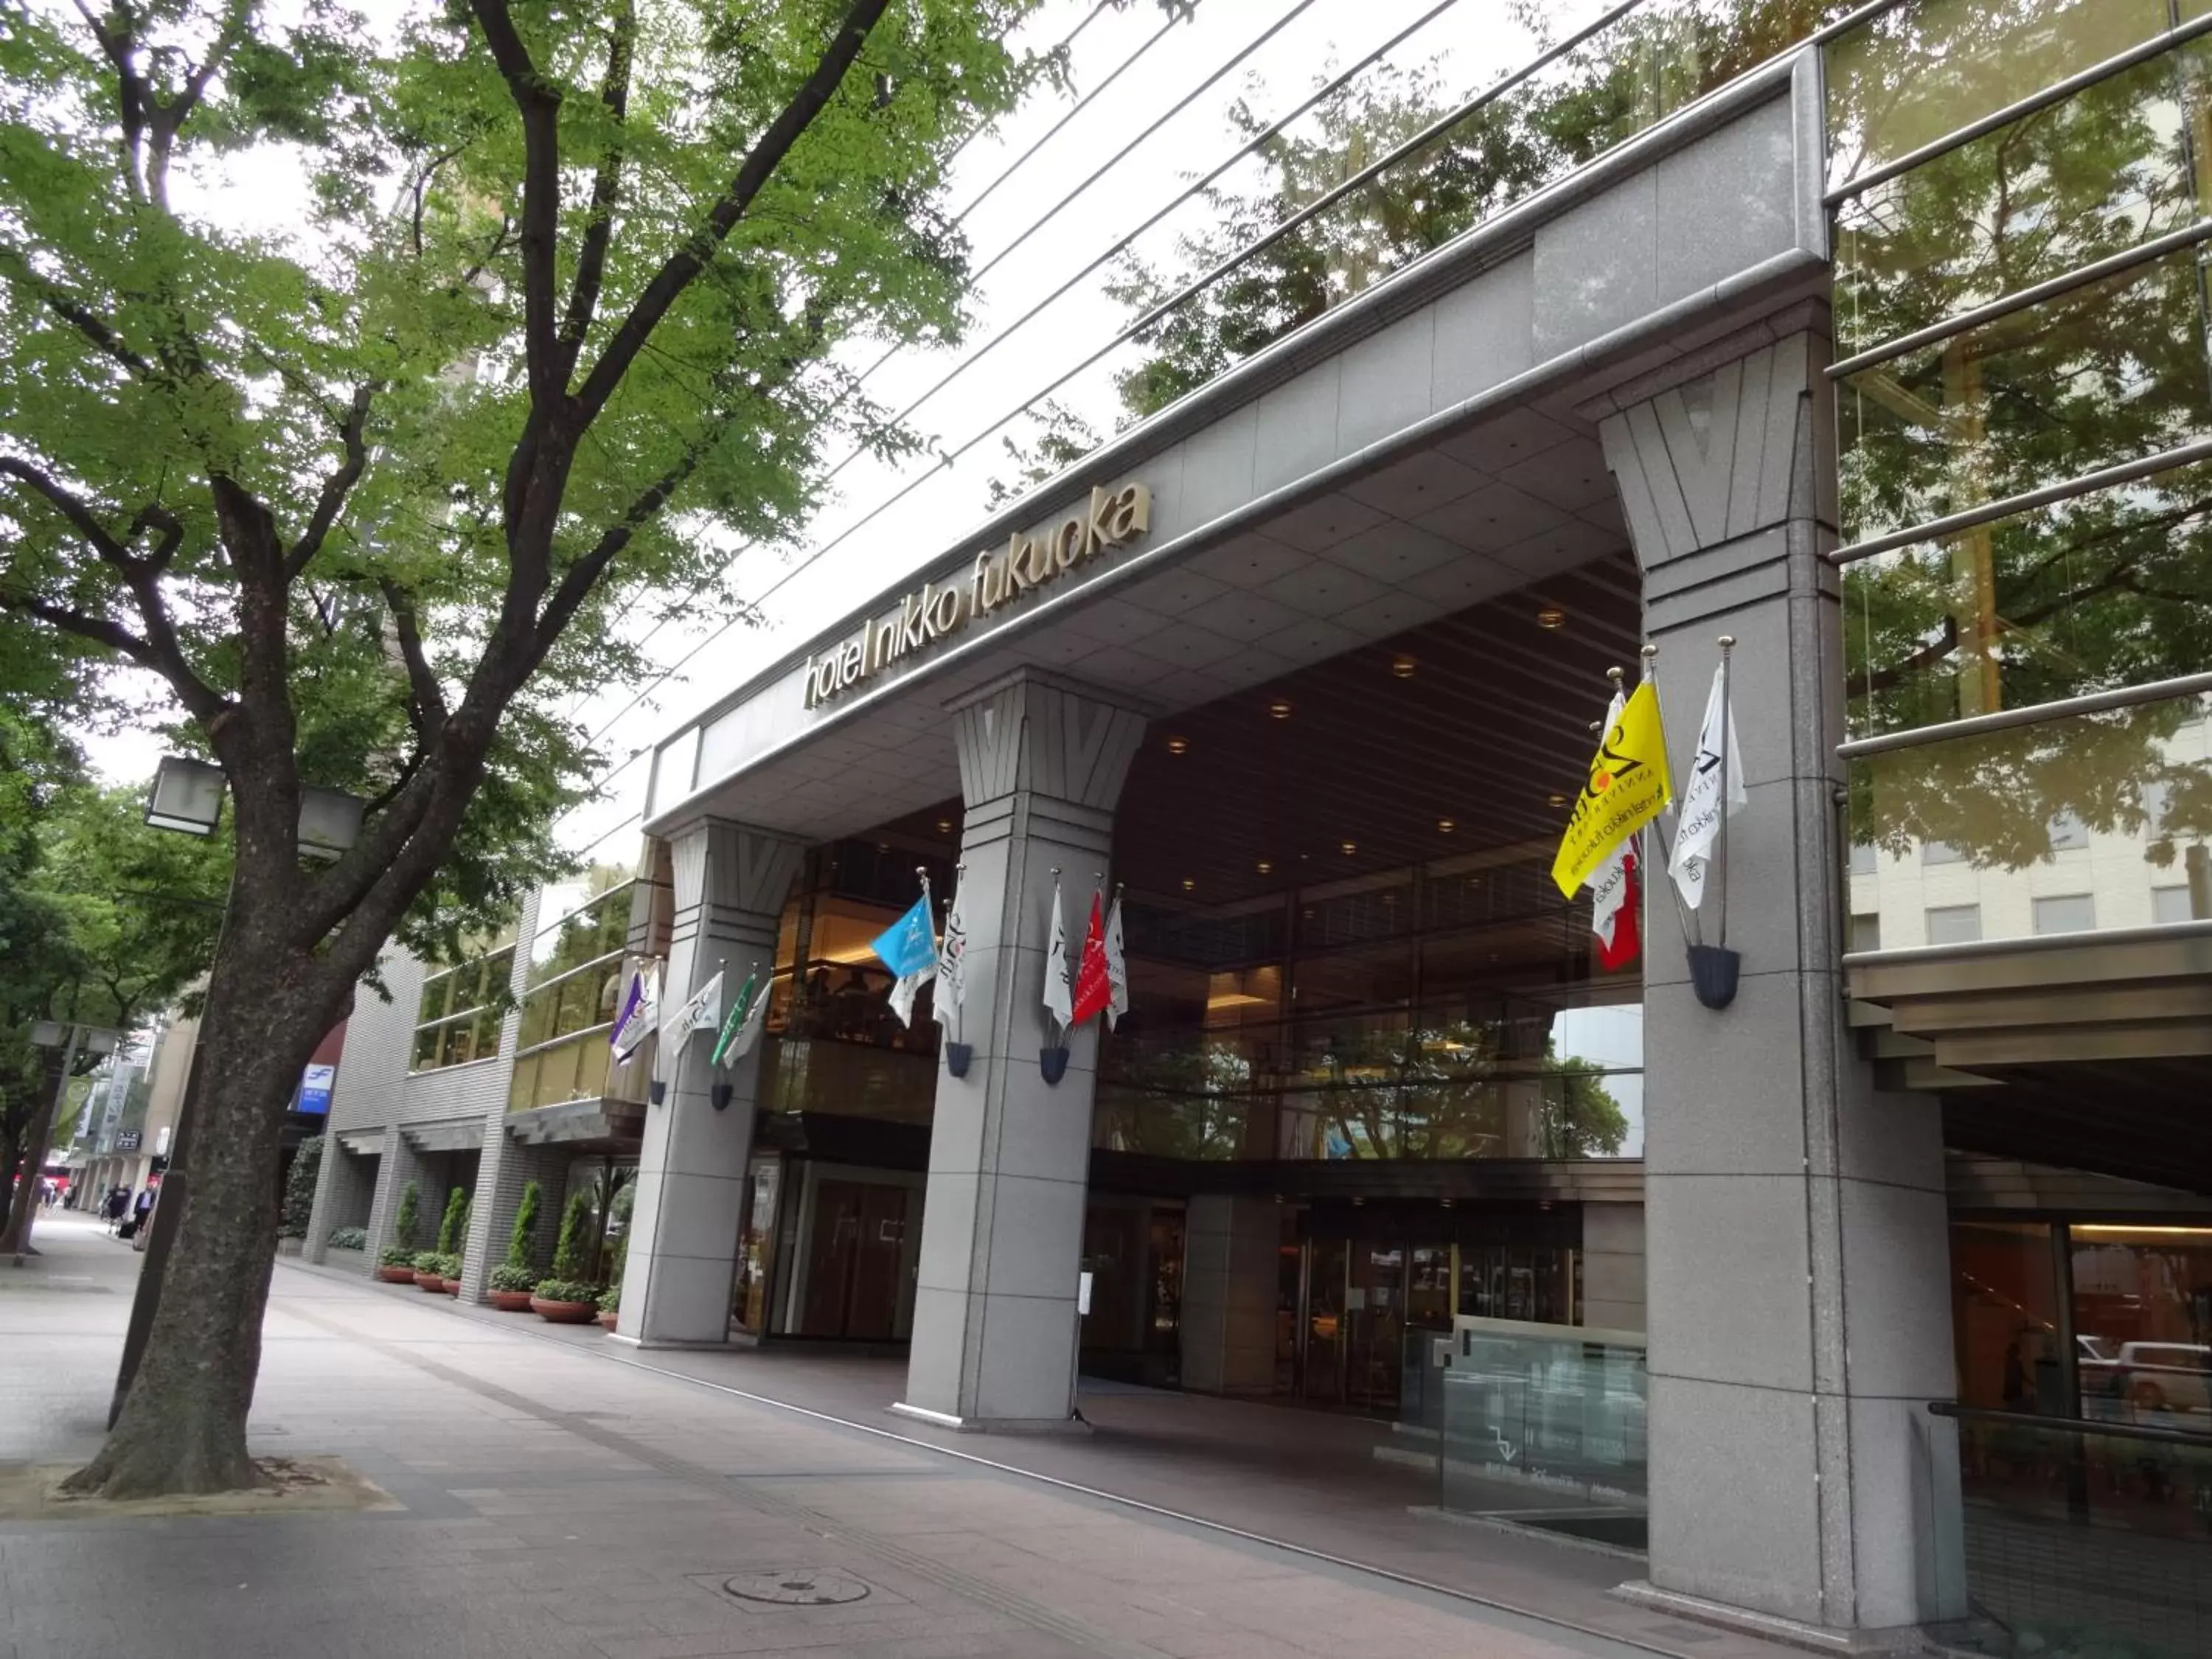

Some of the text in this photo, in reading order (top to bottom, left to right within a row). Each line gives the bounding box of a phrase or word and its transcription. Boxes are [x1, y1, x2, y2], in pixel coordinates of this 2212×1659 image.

[804, 483, 1150, 709] hotel nikko fukuoka
